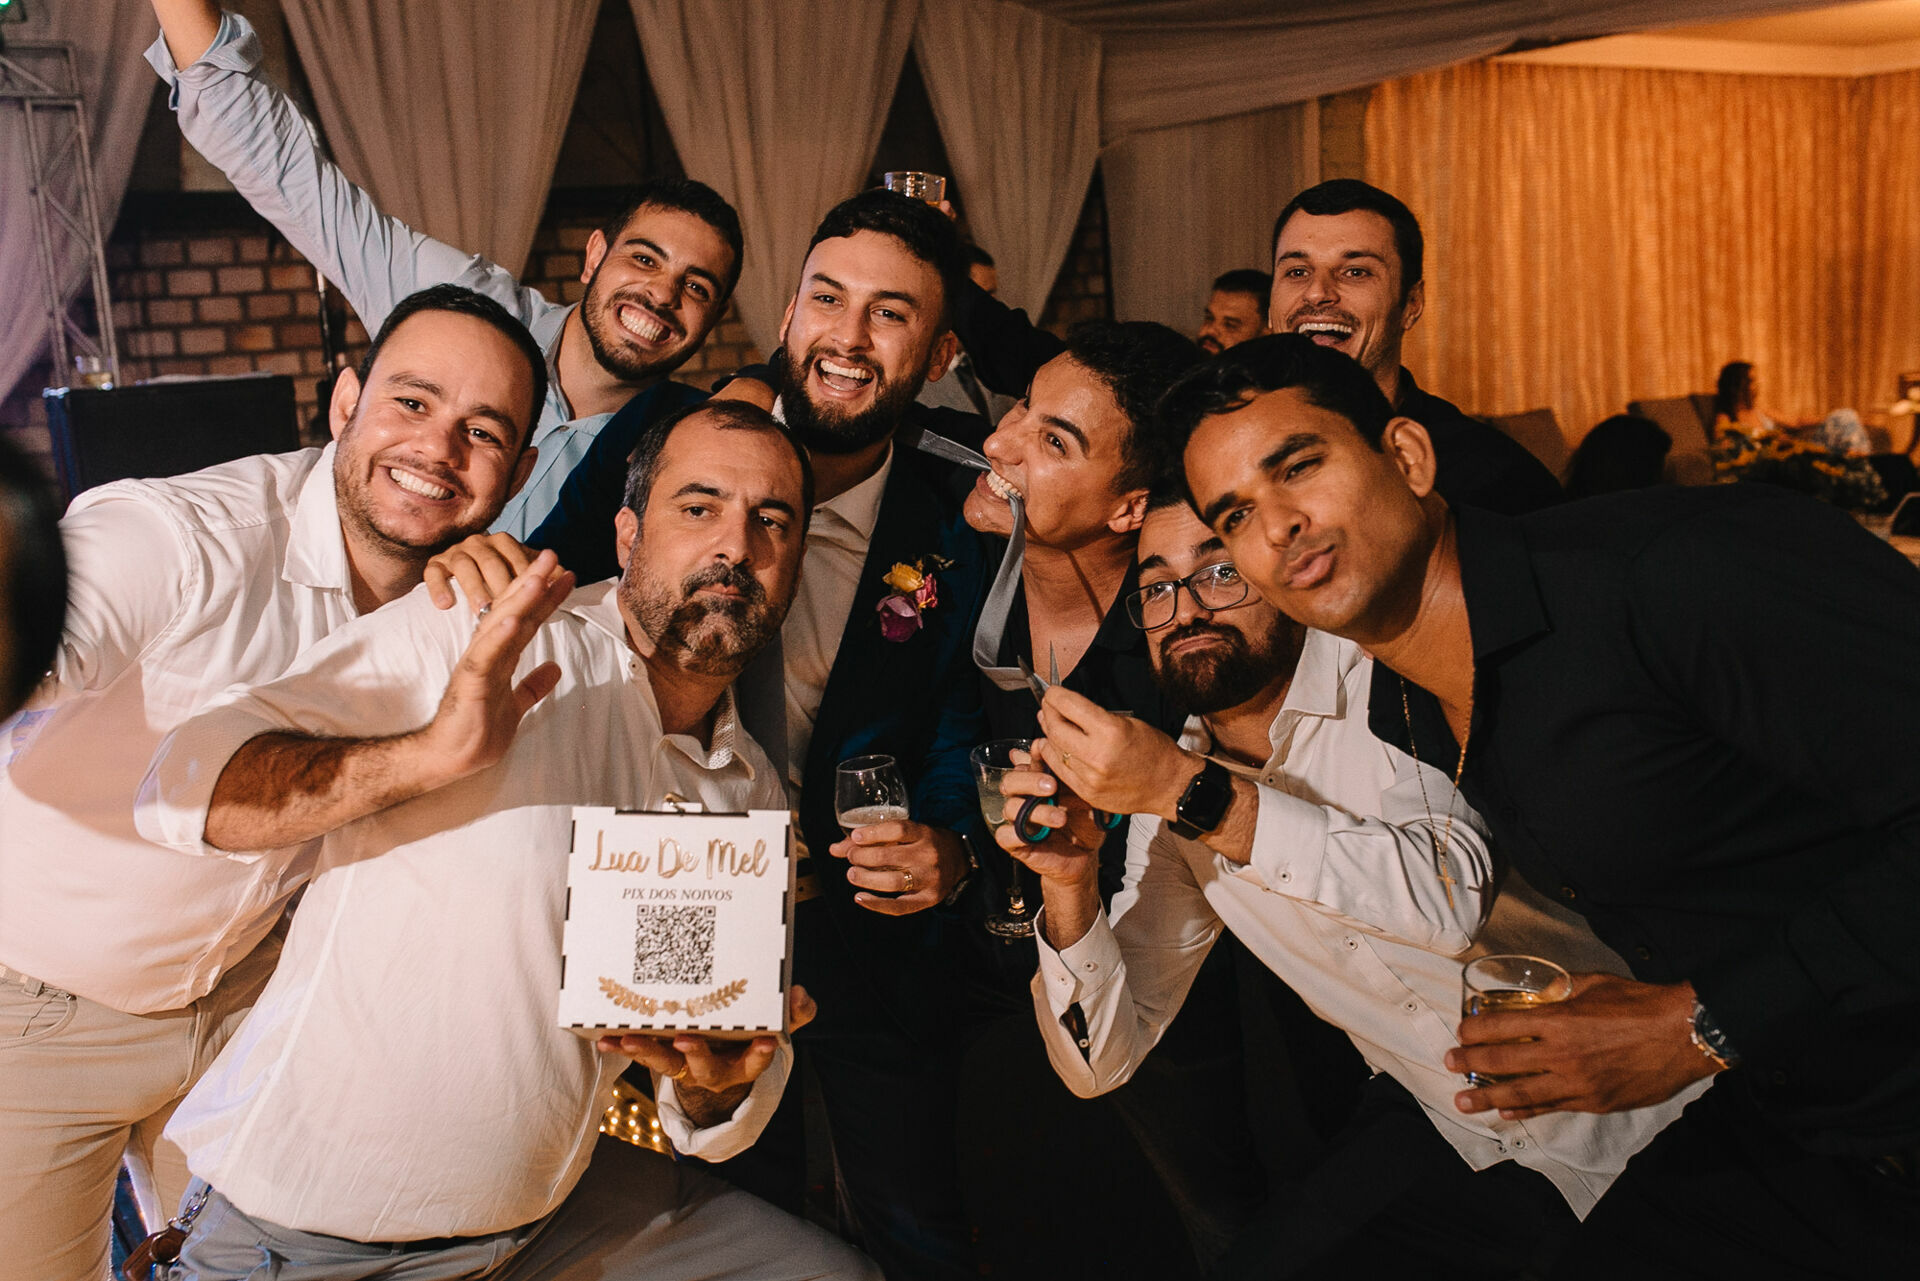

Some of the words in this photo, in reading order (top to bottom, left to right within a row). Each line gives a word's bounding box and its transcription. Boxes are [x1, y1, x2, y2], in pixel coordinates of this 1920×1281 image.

[588, 829, 650, 873] Lua
[658, 837, 699, 879] De
[708, 838, 770, 880] Mel
[622, 888, 645, 900] PIX
[649, 888, 677, 900] DOS
[681, 889, 733, 901] NOIVOS
